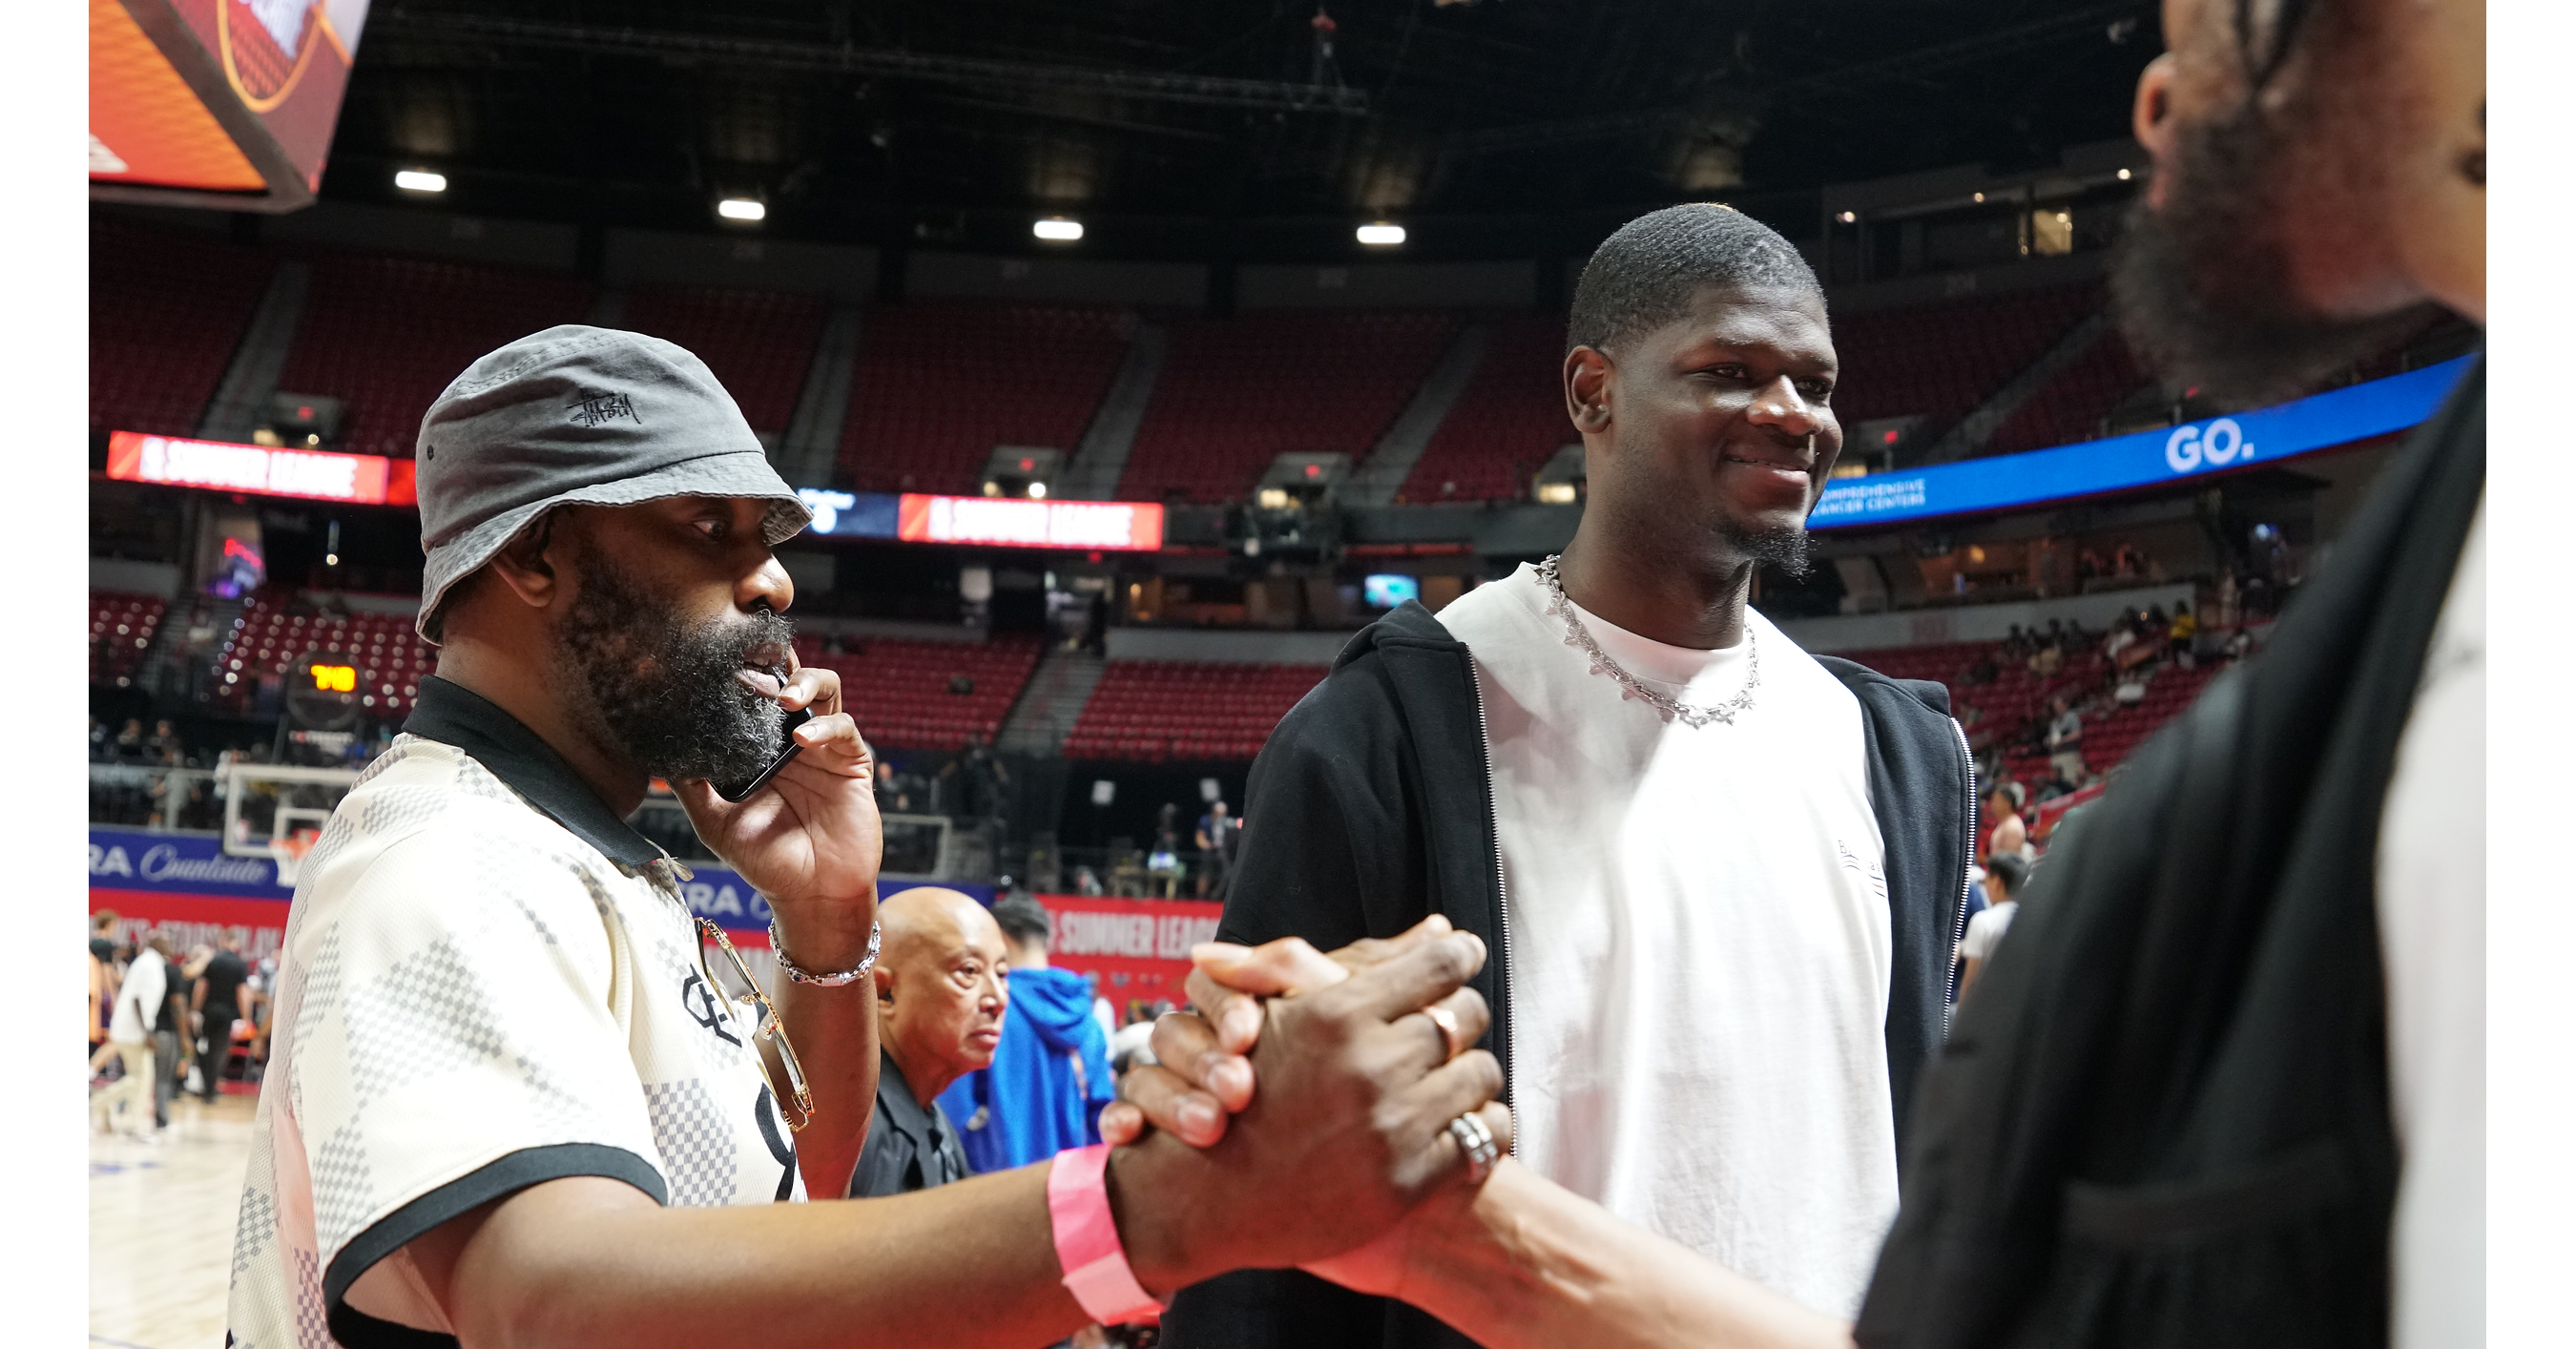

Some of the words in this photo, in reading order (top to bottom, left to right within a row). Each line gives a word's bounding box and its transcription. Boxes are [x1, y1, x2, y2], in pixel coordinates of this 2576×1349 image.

[2165, 418, 2254, 473] GO.
[1820, 477, 1925, 502] OMPREHENSIVE
[1060, 911, 1155, 958] SUMMER
[1157, 915, 1221, 961] LEAG
